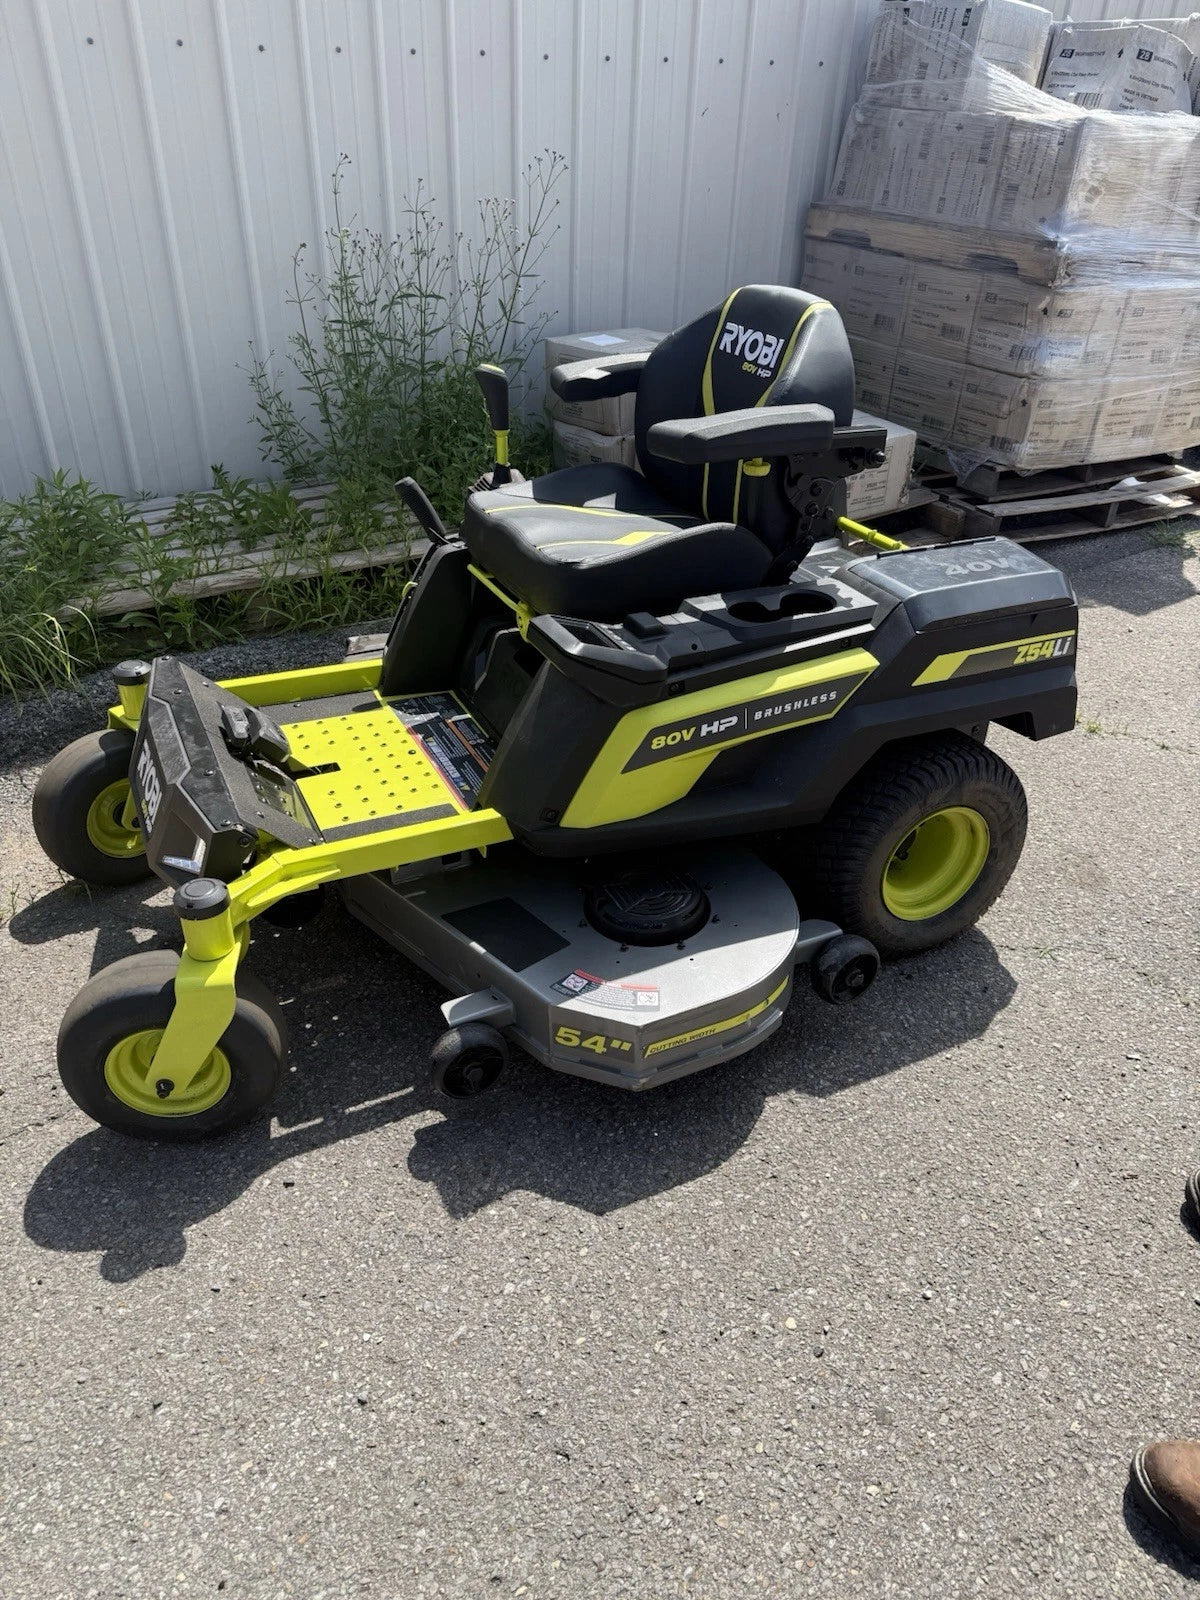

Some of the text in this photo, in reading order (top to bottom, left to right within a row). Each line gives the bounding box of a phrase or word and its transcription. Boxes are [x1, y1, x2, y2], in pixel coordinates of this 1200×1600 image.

[1138, 50, 1153, 61] 28
[719, 322, 785, 369] RYOBI
[757, 367, 772, 378] HP
[1013, 636, 1072, 665] Z54Li
[650, 690, 838, 750] 80V HP BRUSHLESS
[137, 739, 162, 825] RYOBI
[555, 1026, 632, 1054] 54"
[650, 1028, 716, 1054] CUTTING WIDTH
